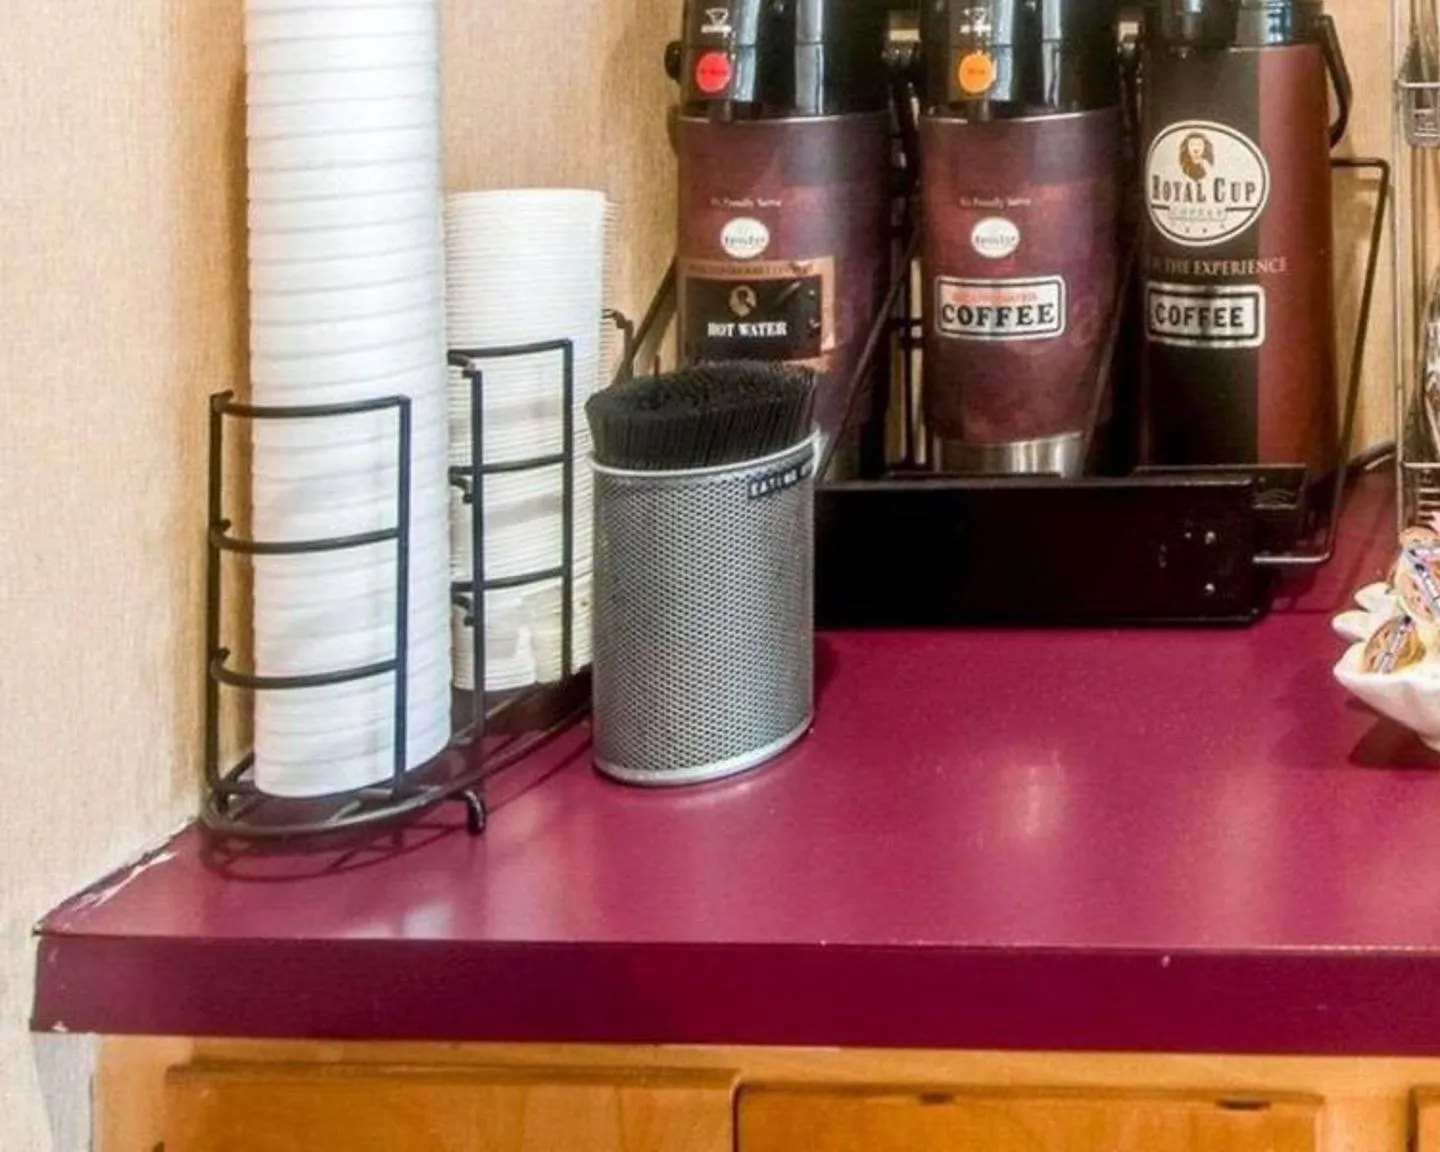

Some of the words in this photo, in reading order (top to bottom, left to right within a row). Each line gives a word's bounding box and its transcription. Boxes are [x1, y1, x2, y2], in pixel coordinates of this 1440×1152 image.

[1193, 256, 1288, 275] EXPERIENCE
[941, 303, 1056, 327] COFFEE
[1154, 302, 1245, 328] COFFEE
[707, 321, 735, 338] HOT
[737, 321, 788, 337] WATER
